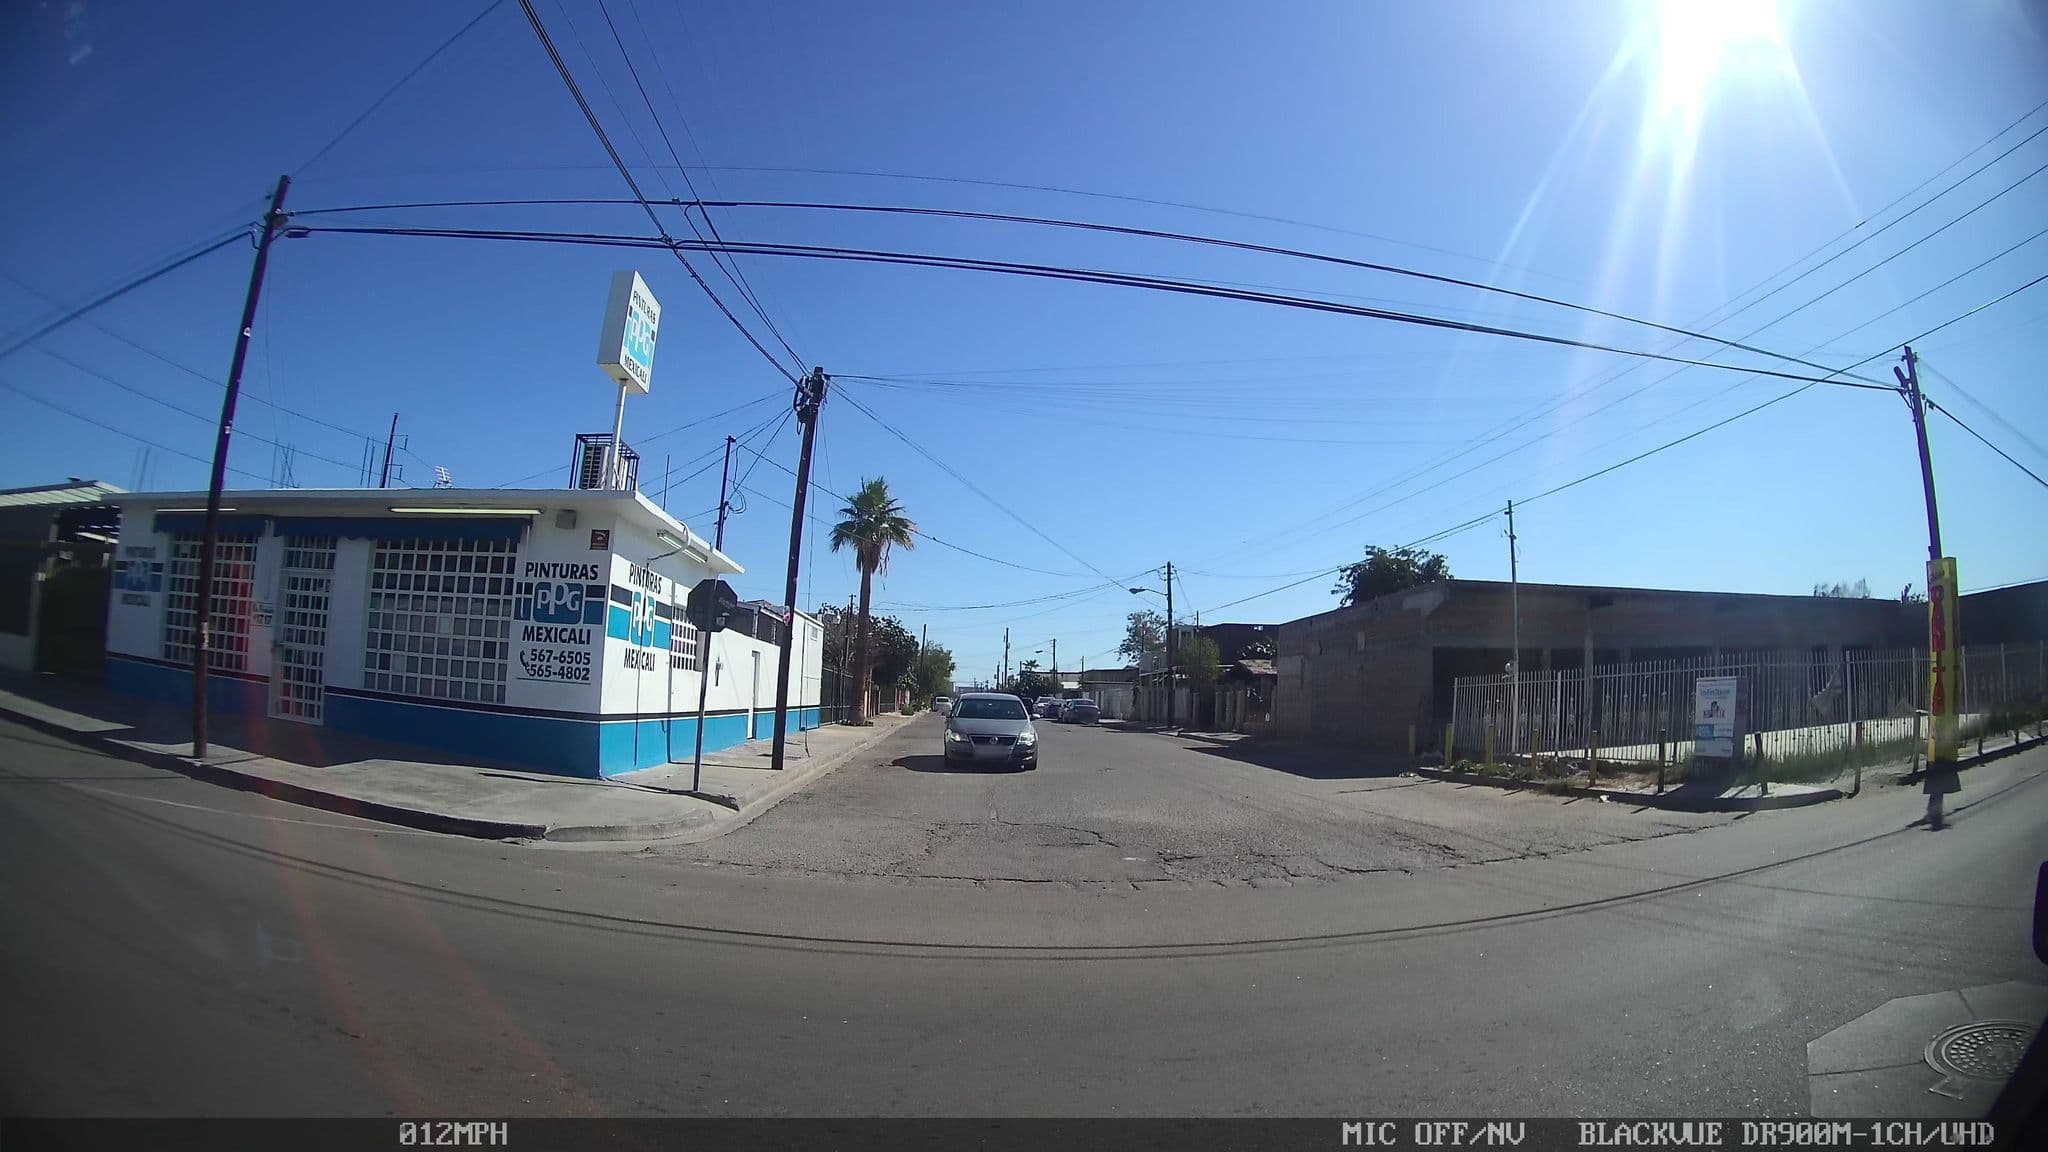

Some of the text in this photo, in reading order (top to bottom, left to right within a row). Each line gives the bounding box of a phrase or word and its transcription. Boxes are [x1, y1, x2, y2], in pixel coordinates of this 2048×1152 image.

[632, 290, 656, 324] PINTURAS
[624, 354, 648, 384] MEXICALI
[525, 562, 599, 580] PINTURAS
[628, 563, 663, 595] PINTURAS
[522, 626, 592, 645] MEXICALI
[530, 649, 591, 665] 567-6505
[624, 647, 656, 672] MEXICALI
[529, 664, 591, 681] 565-4802
